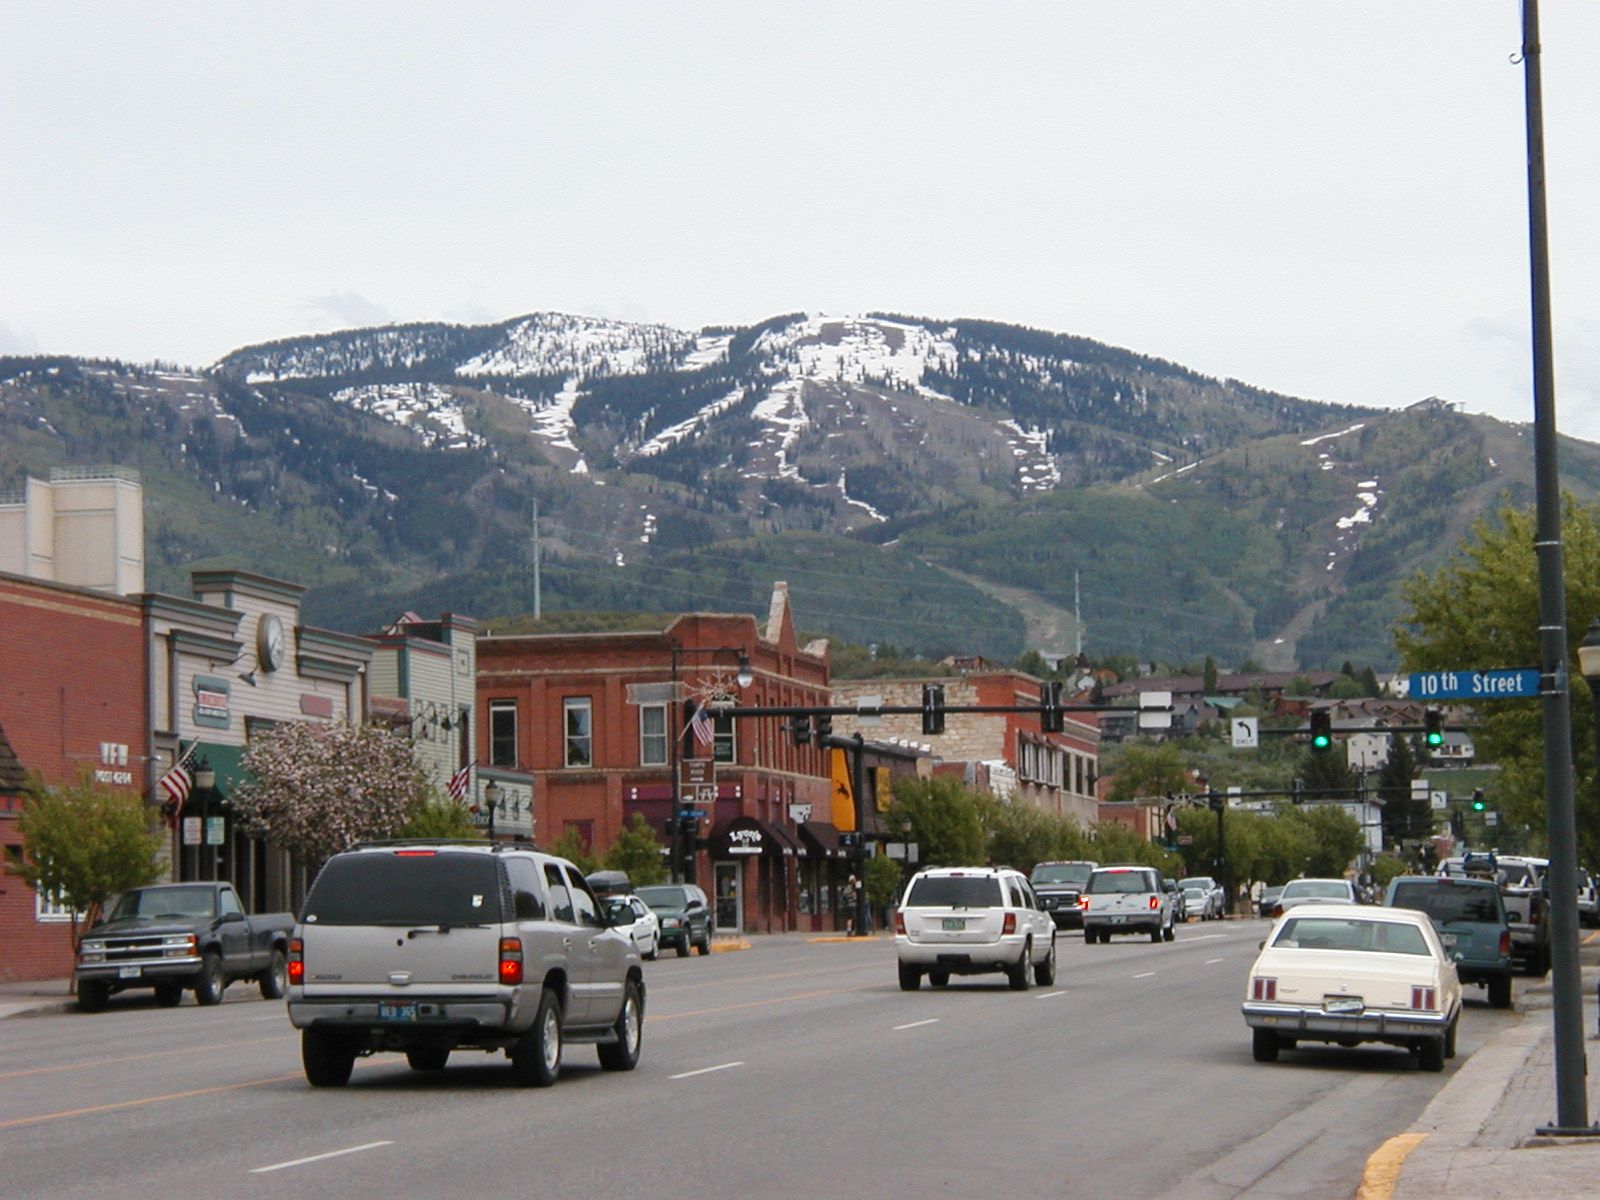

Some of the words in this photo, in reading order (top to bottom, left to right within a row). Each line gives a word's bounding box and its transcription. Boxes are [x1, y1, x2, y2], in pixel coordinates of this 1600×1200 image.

[1420, 672, 1458, 695] 10th
[1471, 673, 1523, 693] Street
[99, 742, 129, 766] VFW
